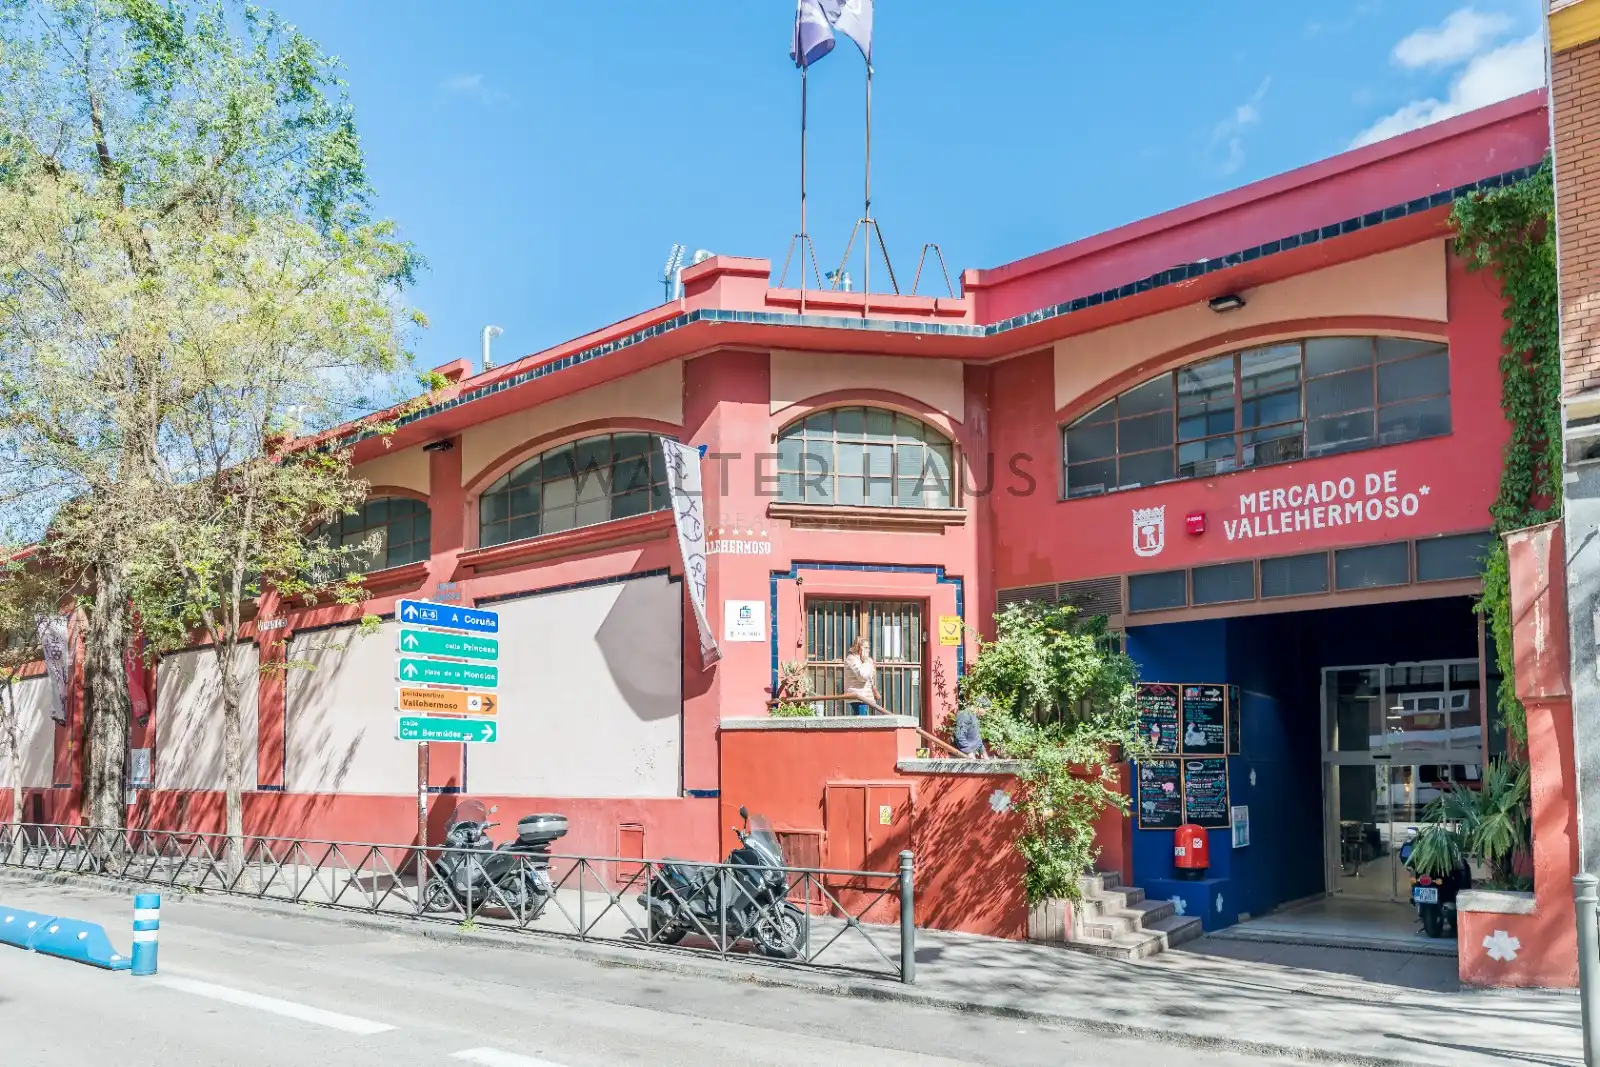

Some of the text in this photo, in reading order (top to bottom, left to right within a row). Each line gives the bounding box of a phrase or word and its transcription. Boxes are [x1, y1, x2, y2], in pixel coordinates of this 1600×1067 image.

[1239, 469, 1398, 515] MERCADO DE
[706, 539, 771, 555] LLEHERMOSO
[452, 613, 459, 622] A
[464, 615, 496, 627] Coruña
[463, 643, 496, 653] Princesa
[403, 698, 458, 709] Vallehermoso
